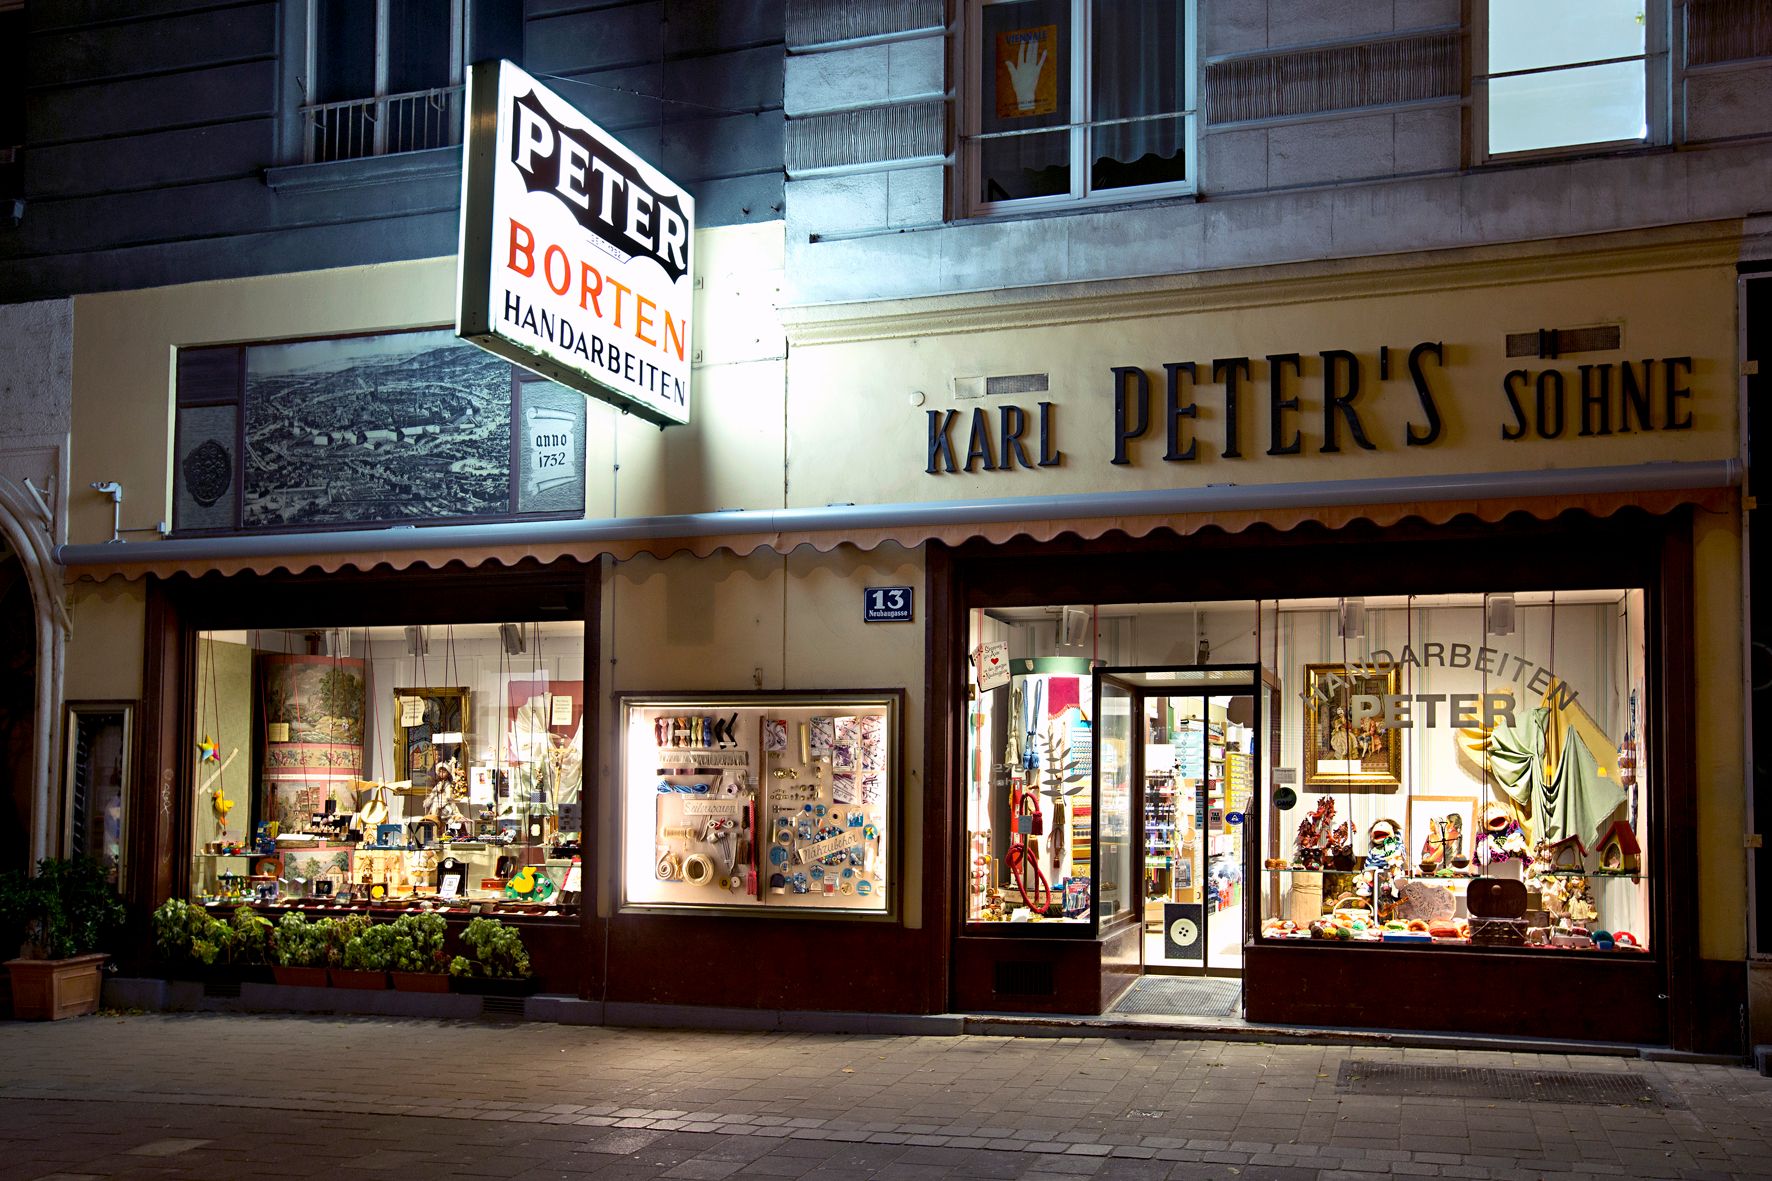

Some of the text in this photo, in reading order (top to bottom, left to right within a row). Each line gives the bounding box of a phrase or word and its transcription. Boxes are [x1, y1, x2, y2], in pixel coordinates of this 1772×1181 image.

[515, 99, 687, 270] PETER
[507, 217, 687, 362] BORTEN
[504, 289, 686, 406] HANDARBEITEN
[925, 329, 1692, 474] KARL PETER'S SÖHNE
[536, 434, 567, 447] anno
[868, 610, 908, 618] Neubaugasse
[872, 589, 904, 609] 13
[1298, 642, 1580, 712] HANDARBEITEN
[1351, 693, 1517, 729] PETER
